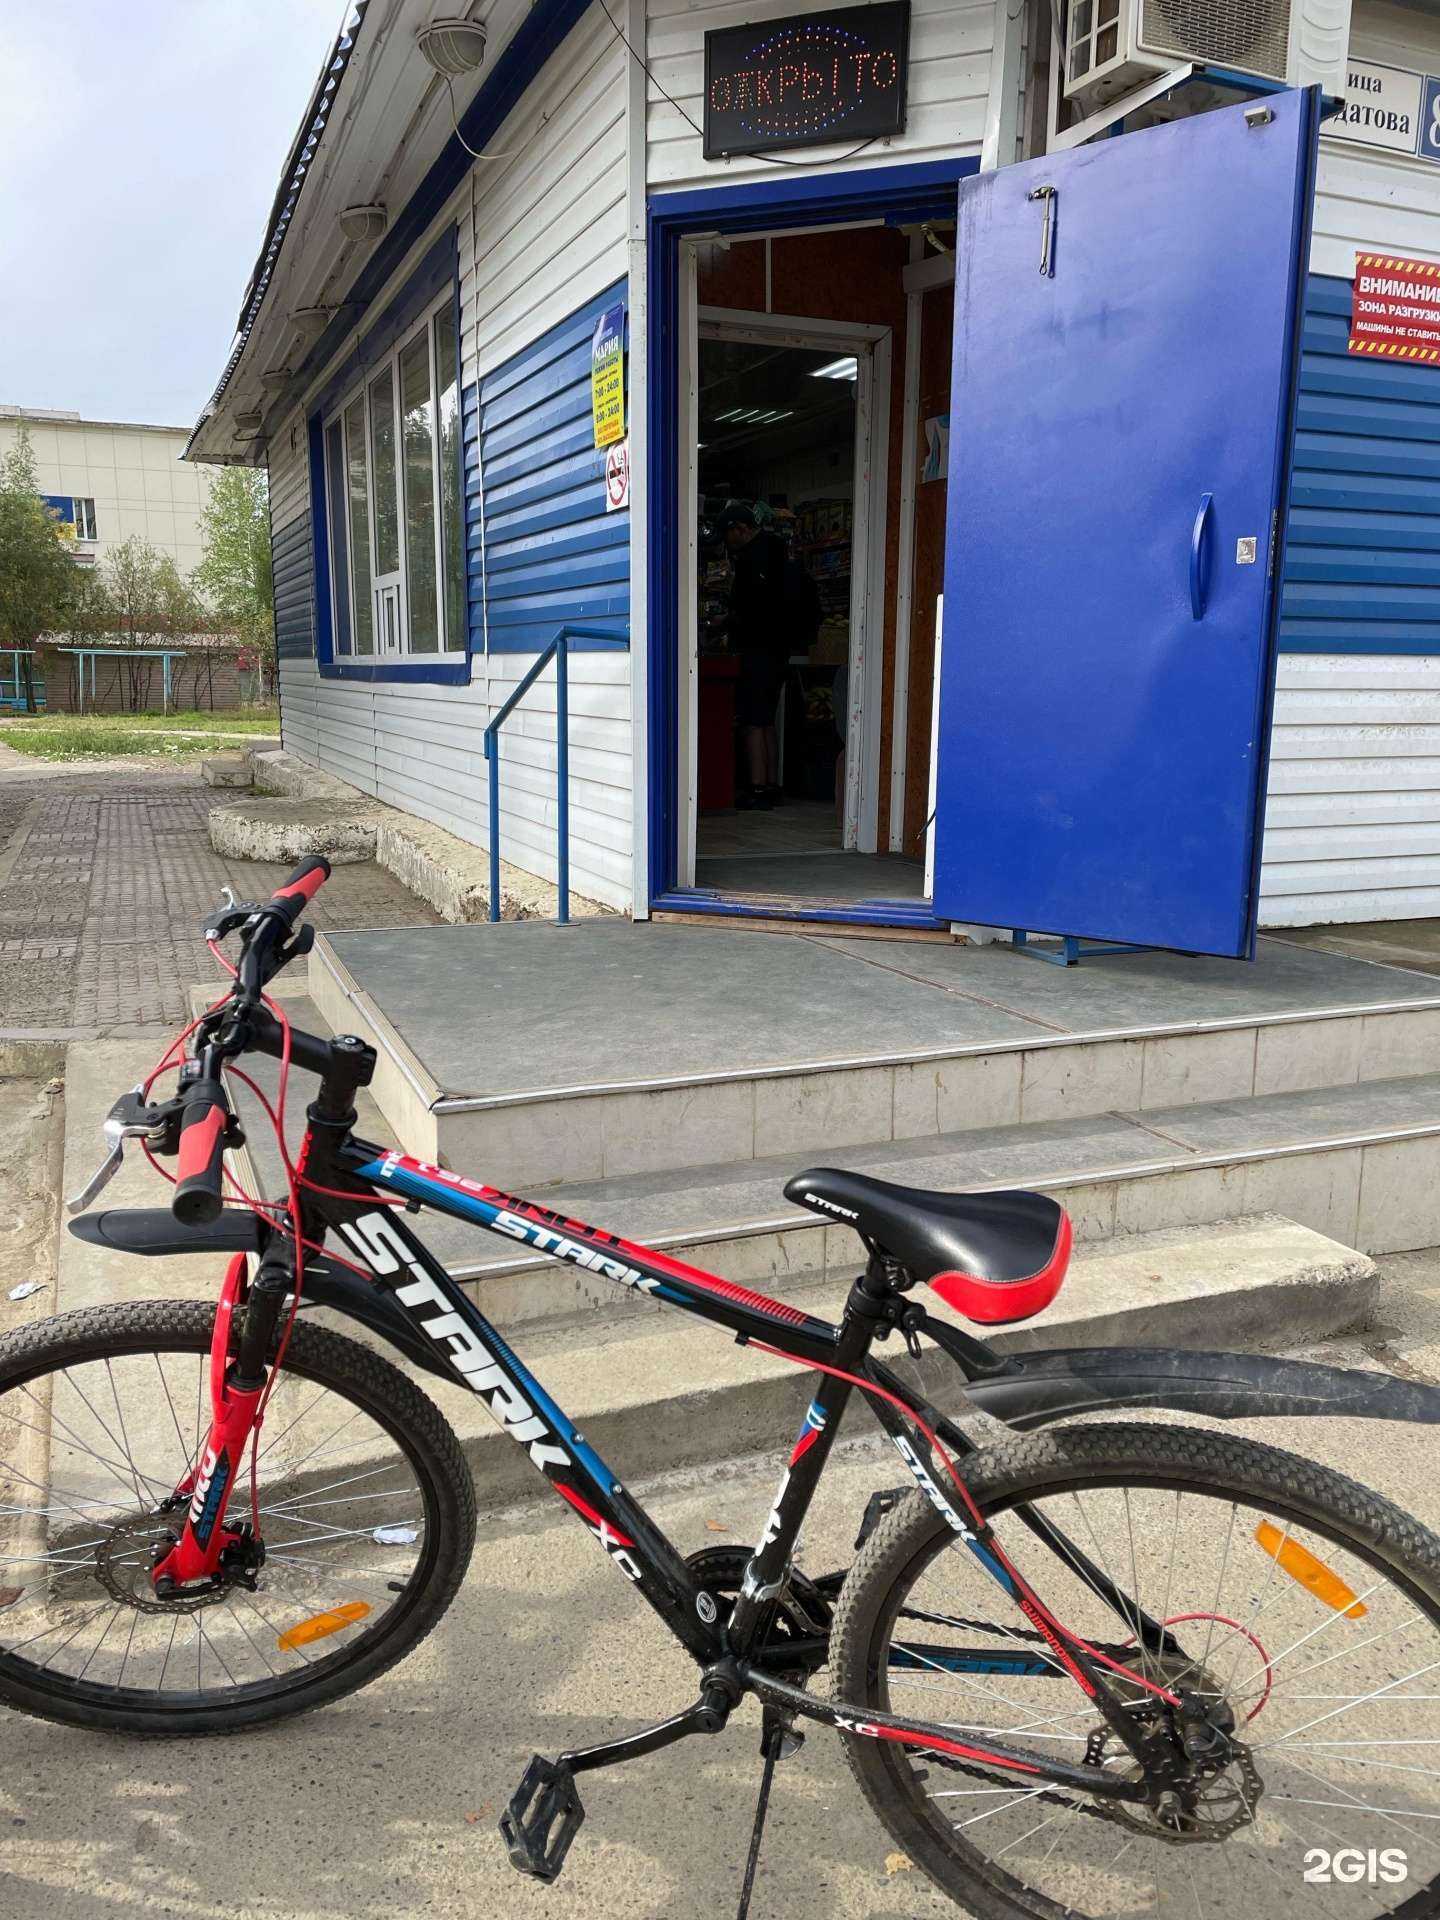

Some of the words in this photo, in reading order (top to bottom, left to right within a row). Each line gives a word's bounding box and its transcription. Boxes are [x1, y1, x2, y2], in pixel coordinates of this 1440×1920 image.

[711, 51, 896, 111] ОТКРЫТО
[1347, 73, 1382, 94] ица
[1333, 102, 1410, 134] датова
[1358, 300, 1386, 315] ЗОНА
[1356, 321, 1394, 334] МАШИНЫ
[1395, 327, 1406, 336] НЕ
[804, 1192, 860, 1220] STARK
[491, 1210, 660, 1294] STARK
[339, 1211, 572, 1472] STARK
[893, 1434, 976, 1541] STARK
